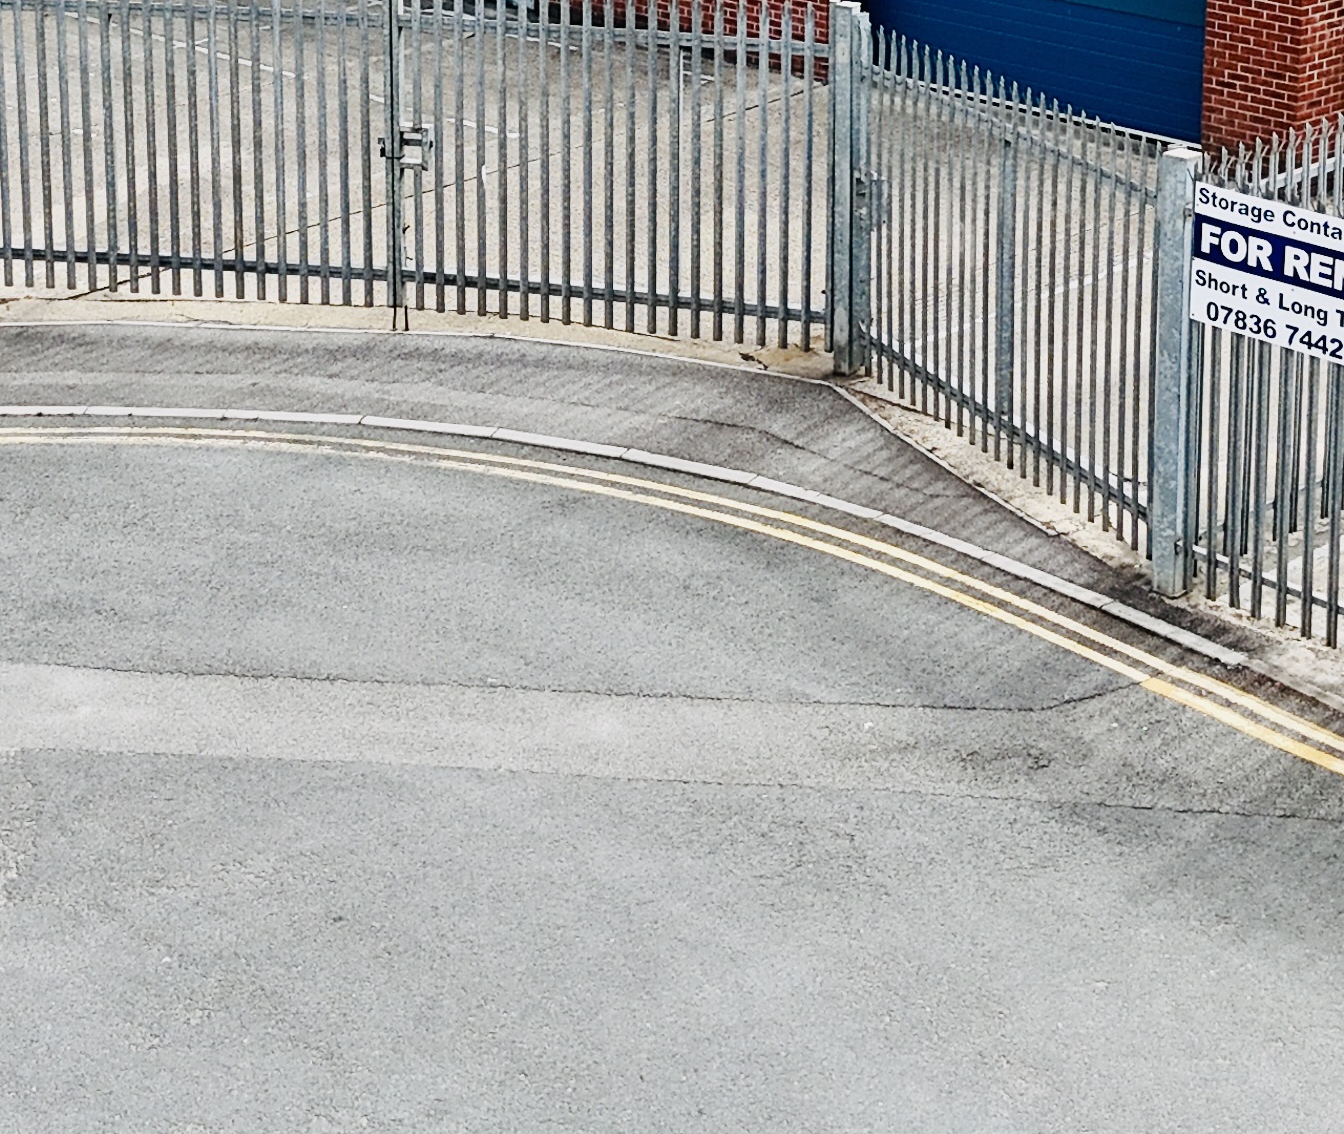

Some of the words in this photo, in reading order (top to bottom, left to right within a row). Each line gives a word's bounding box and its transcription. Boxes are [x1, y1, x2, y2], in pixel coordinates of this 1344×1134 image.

[1198, 187, 1275, 223] Storage
[1200, 222, 1273, 272] FOR
[1195, 269, 1248, 300] Short
[1255, 287, 1271, 306] &
[1278, 292, 1328, 326] Long
[1206, 301, 1277, 339] 07836
